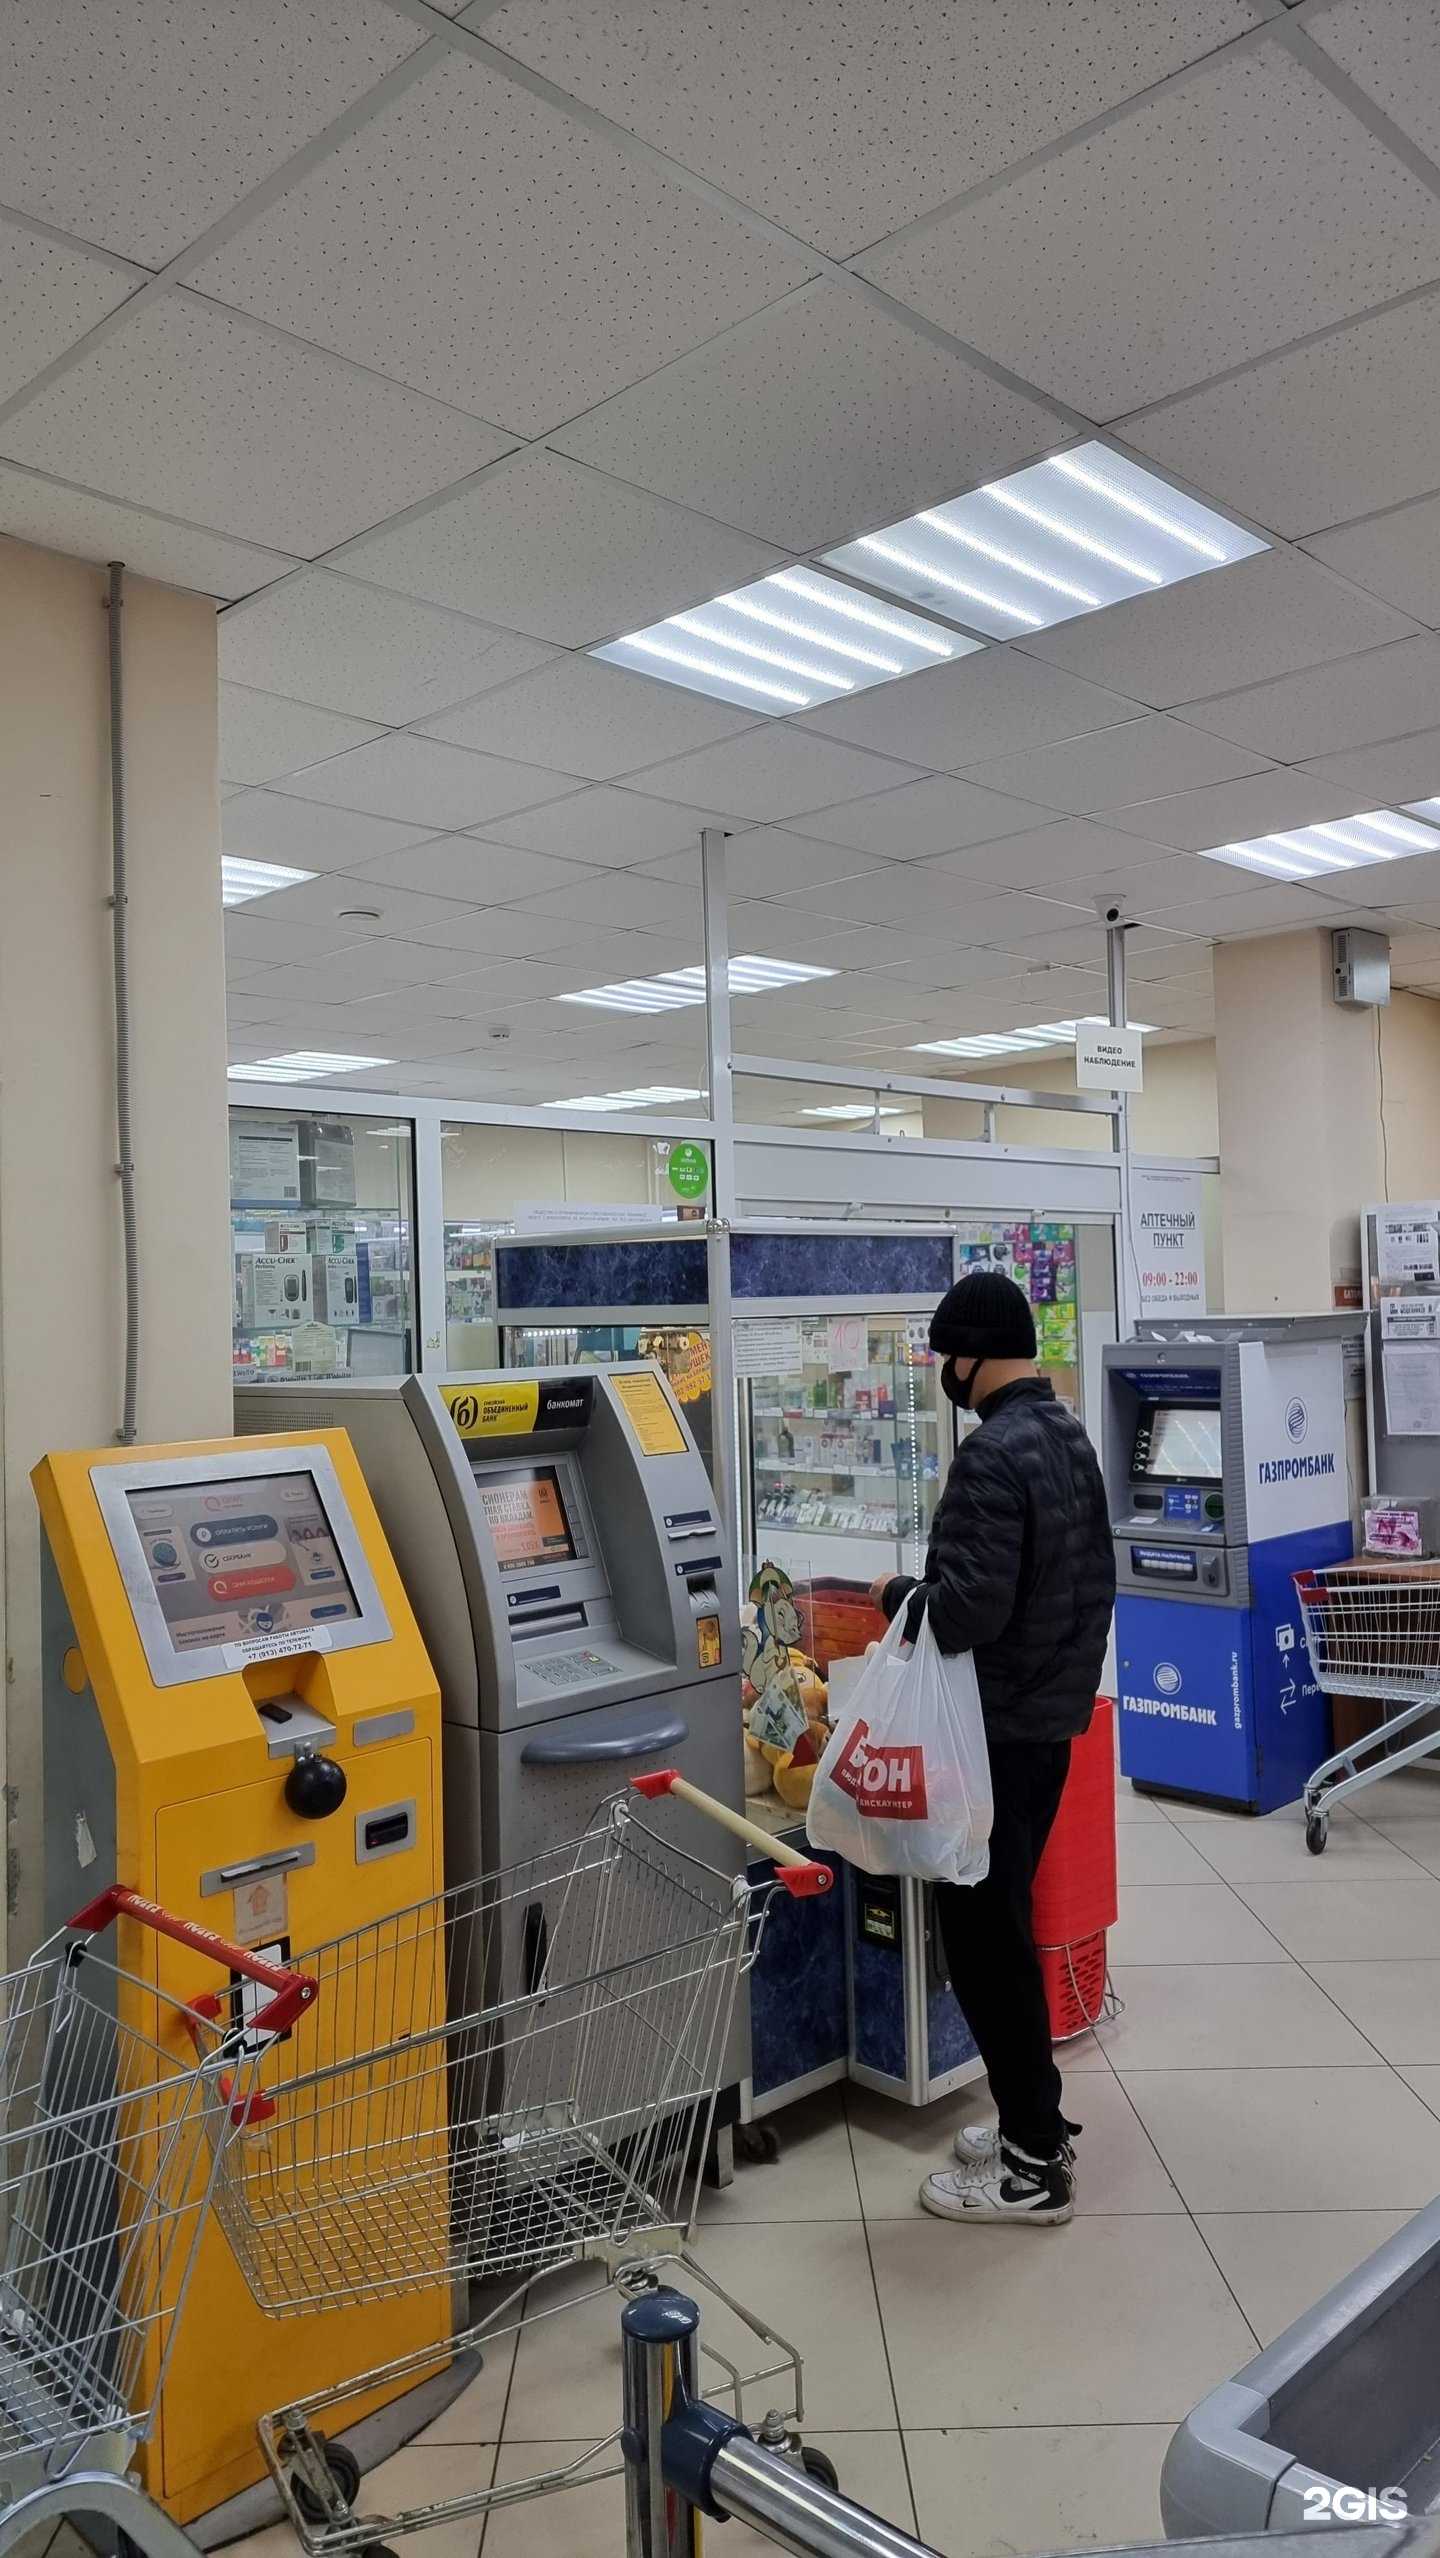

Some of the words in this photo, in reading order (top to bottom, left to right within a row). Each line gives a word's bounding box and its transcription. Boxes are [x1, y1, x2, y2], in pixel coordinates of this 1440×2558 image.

[1097, 1045, 1122, 1054] ВИДЕО
[1083, 1056, 1136, 1068] НАБЛЮДЕНИЕ
[1141, 1211, 1195, 1227] АПТЕЧНЫЙ
[1153, 1233, 1184, 1247] ПУНКТ
[1142, 1271, 1167, 1287] 09:00
[1175, 1271, 1199, 1286] 22:00
[482, 1402, 529, 1414] ОБЪЕДИНЕННЫЙ
[547, 1399, 585, 1410] банкомат
[481, 1415, 497, 1423] БАНК
[1258, 1452, 1336, 1485] ГАЗПРОМБАНК
[1230, 1651, 1242, 1730] gazprombank.ru
[1122, 1695, 1218, 1726] ГАЗПРОМБАНК
